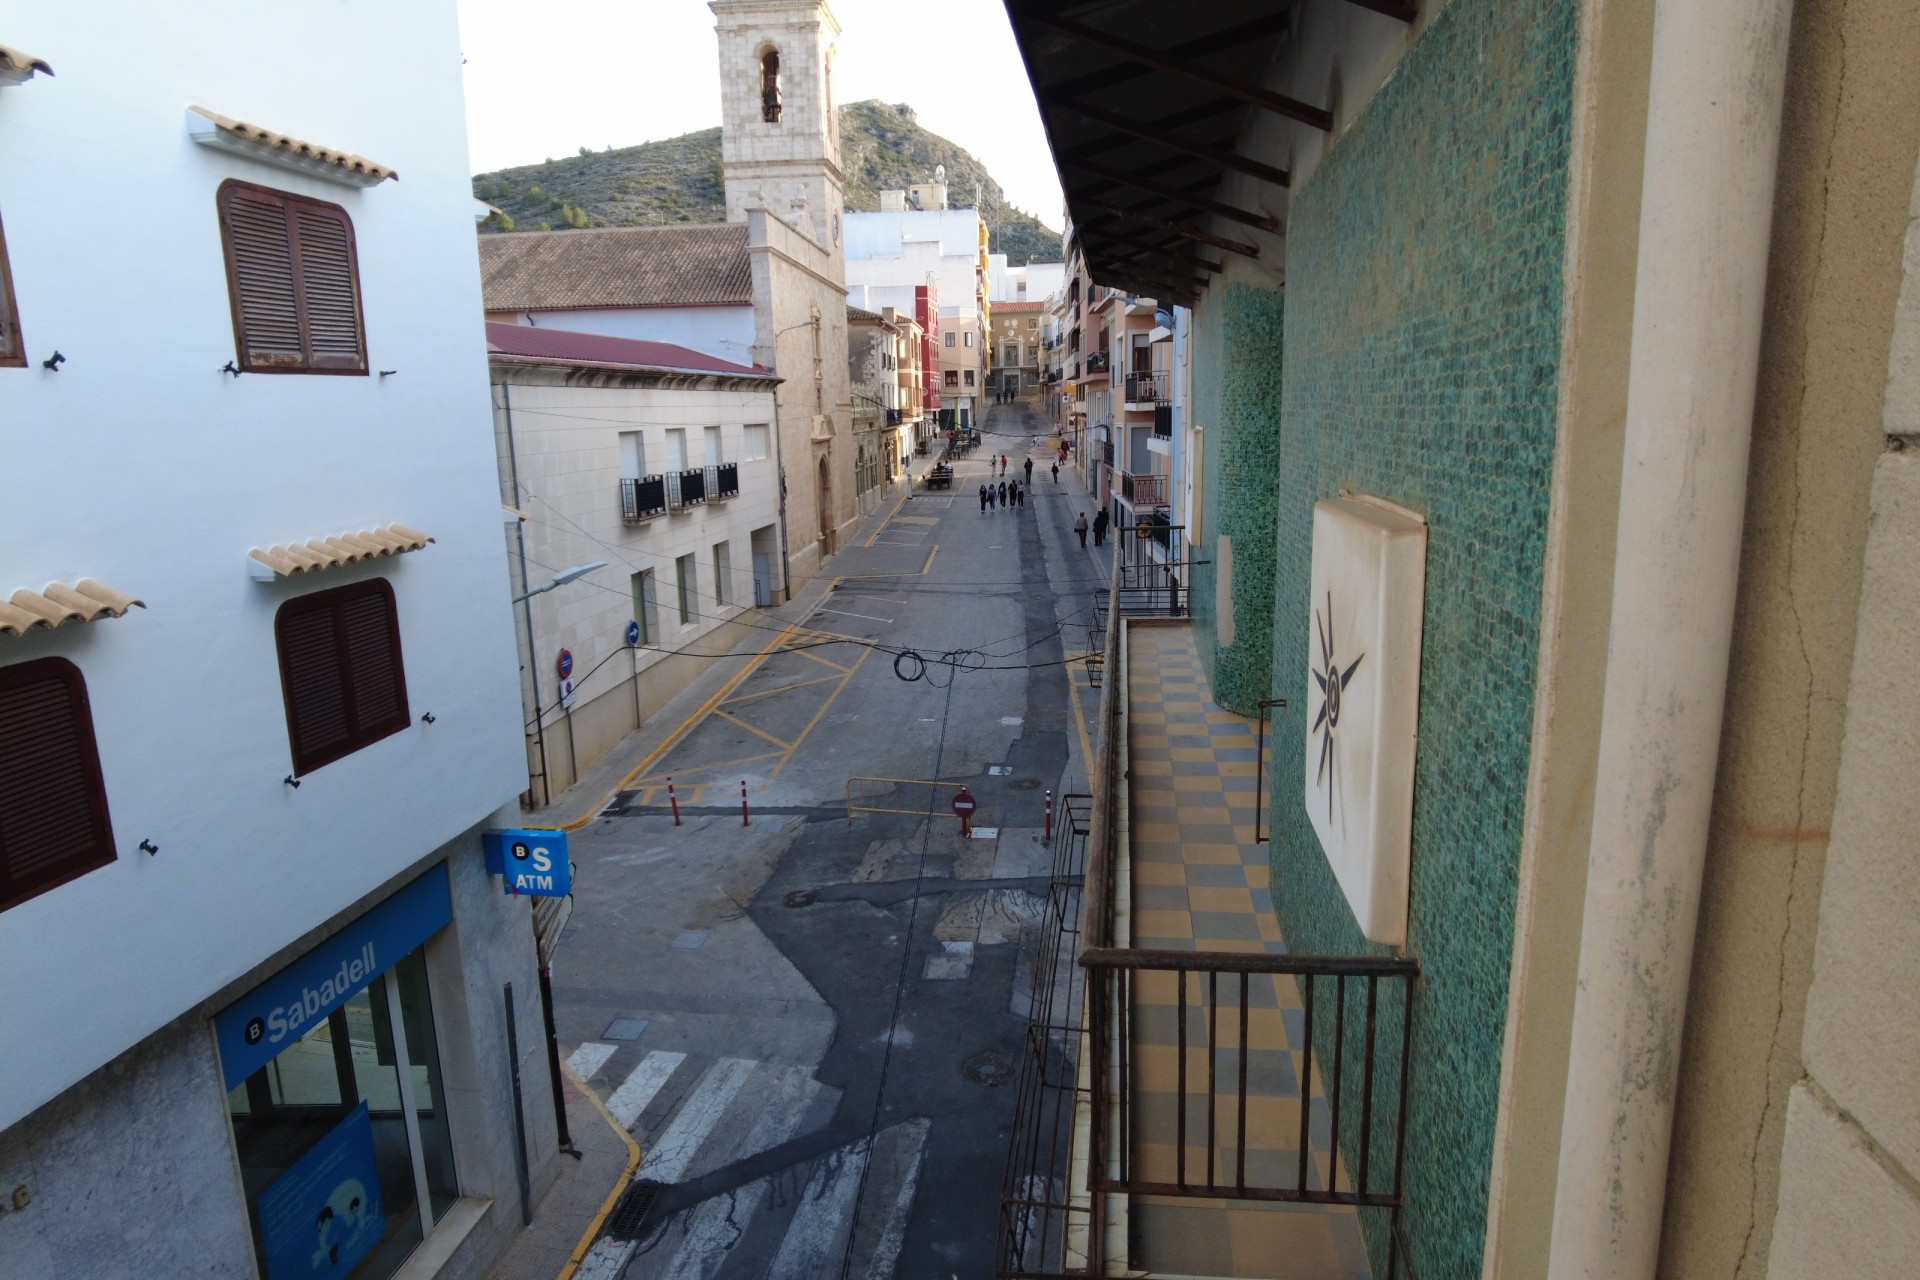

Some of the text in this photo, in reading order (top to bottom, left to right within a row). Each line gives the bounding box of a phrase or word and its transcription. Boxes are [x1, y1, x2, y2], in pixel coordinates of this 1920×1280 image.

[515, 846, 552, 872] B S
[515, 874, 553, 891] ATM
[249, 941, 376, 1043] B Sabadell
